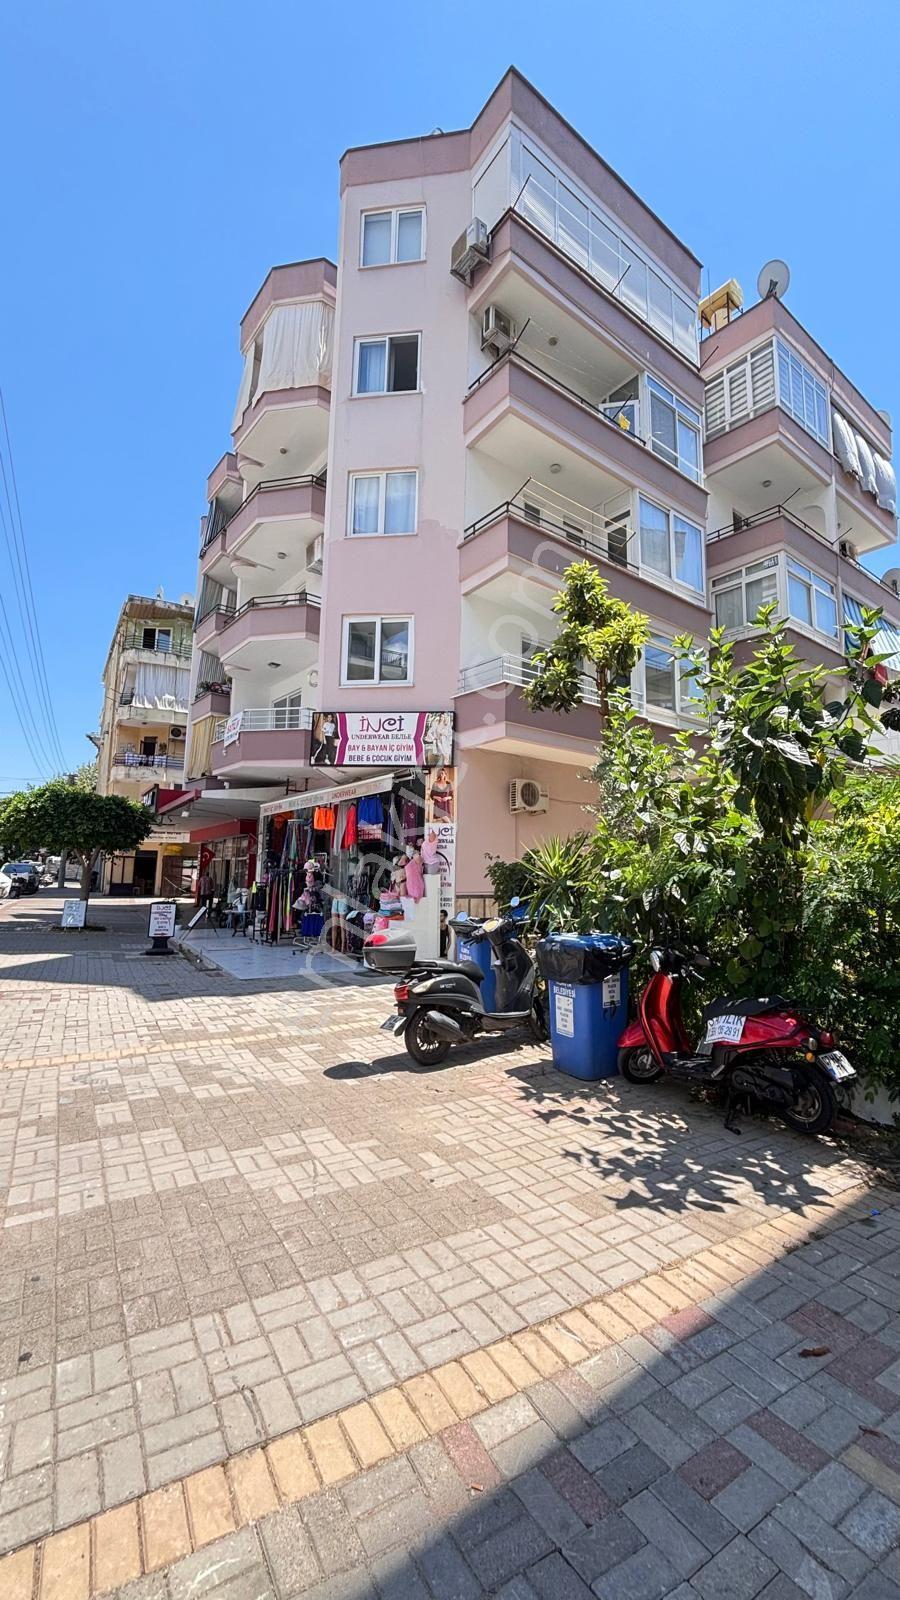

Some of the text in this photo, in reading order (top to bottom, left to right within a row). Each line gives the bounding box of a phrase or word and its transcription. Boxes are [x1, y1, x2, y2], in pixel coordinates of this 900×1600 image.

[348, 753, 412, 763] BEBE & ÇOCUK GİYİM
